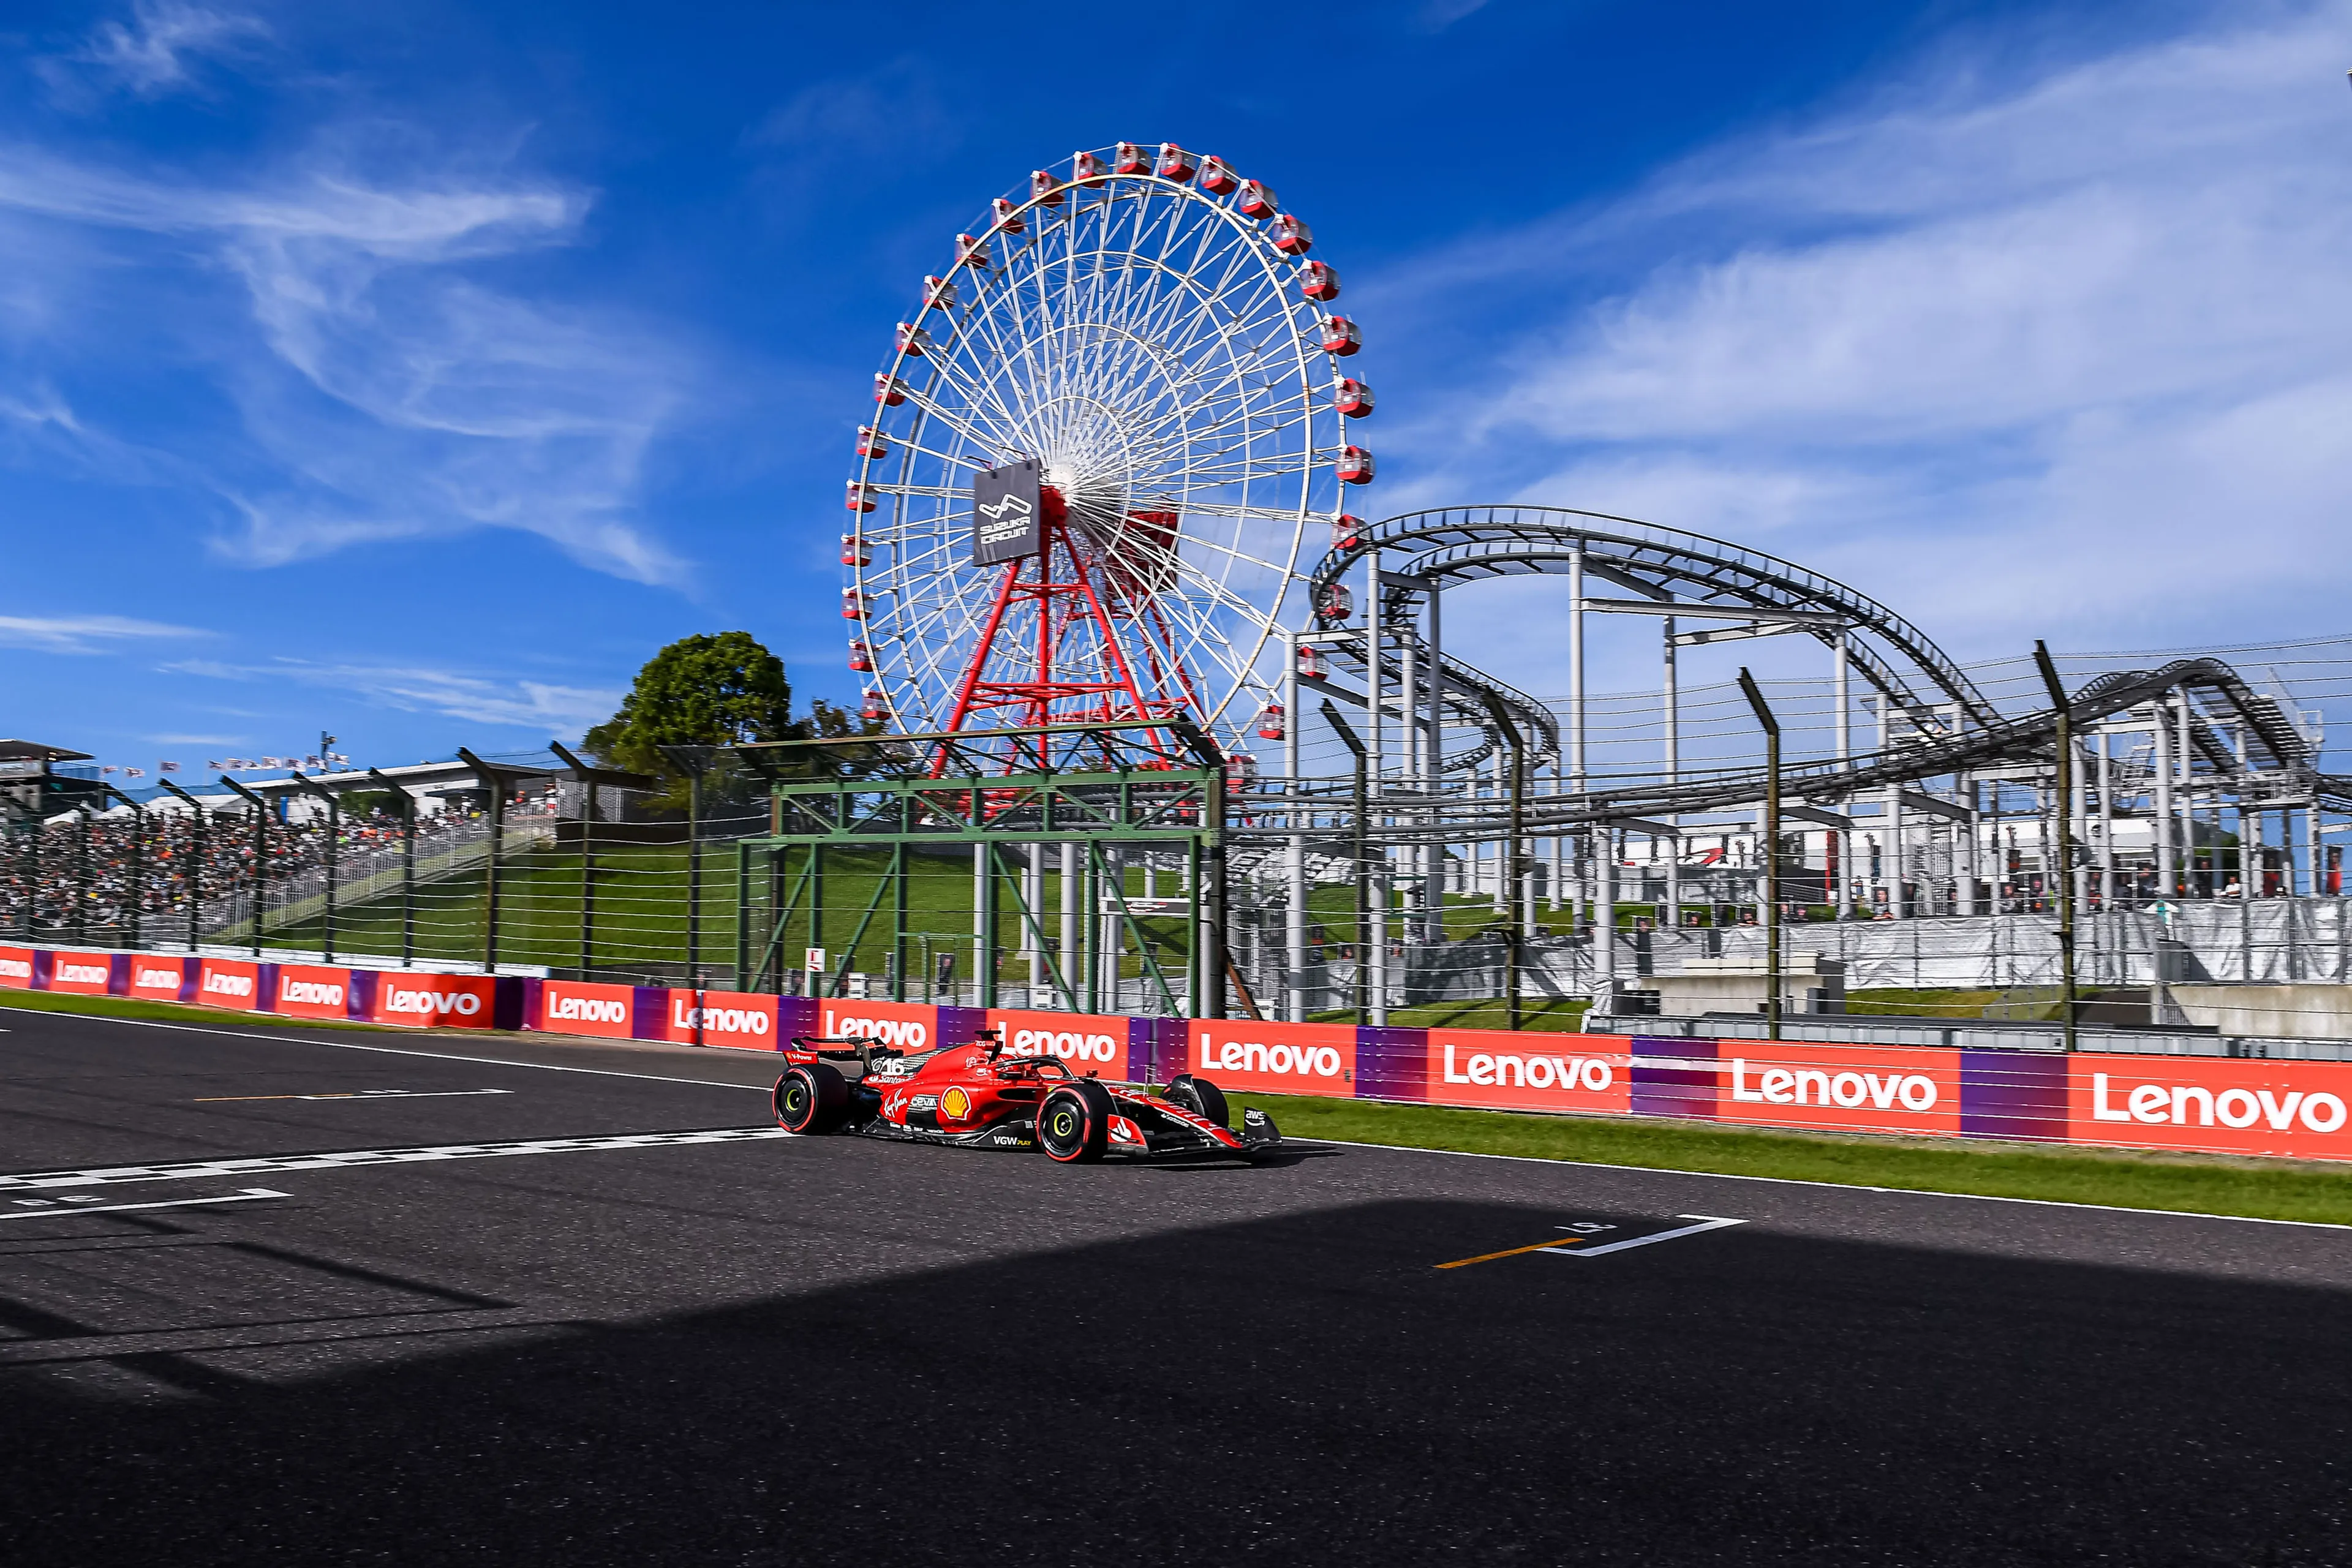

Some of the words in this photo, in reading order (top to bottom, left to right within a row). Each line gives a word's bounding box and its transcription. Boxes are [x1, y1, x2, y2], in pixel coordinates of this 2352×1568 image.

[282, 976, 343, 1006] Lenovo
[385, 984, 481, 1015] Lenovo
[549, 991, 626, 1023] Lenovo
[674, 999, 769, 1035] Lenovo
[825, 1009, 927, 1047] Lenovo
[998, 1021, 1116, 1063] Lenovo
[1200, 1033, 1341, 1077] Lenovo
[881, 1058, 905, 1076] 16
[1444, 1044, 1613, 1091] Lenovo
[1732, 1057, 1938, 1112] Lenovo
[1245, 1110, 1266, 1120] aws
[2092, 1072, 2347, 1133] Lenovo
[993, 1136, 1017, 1145] VGW
